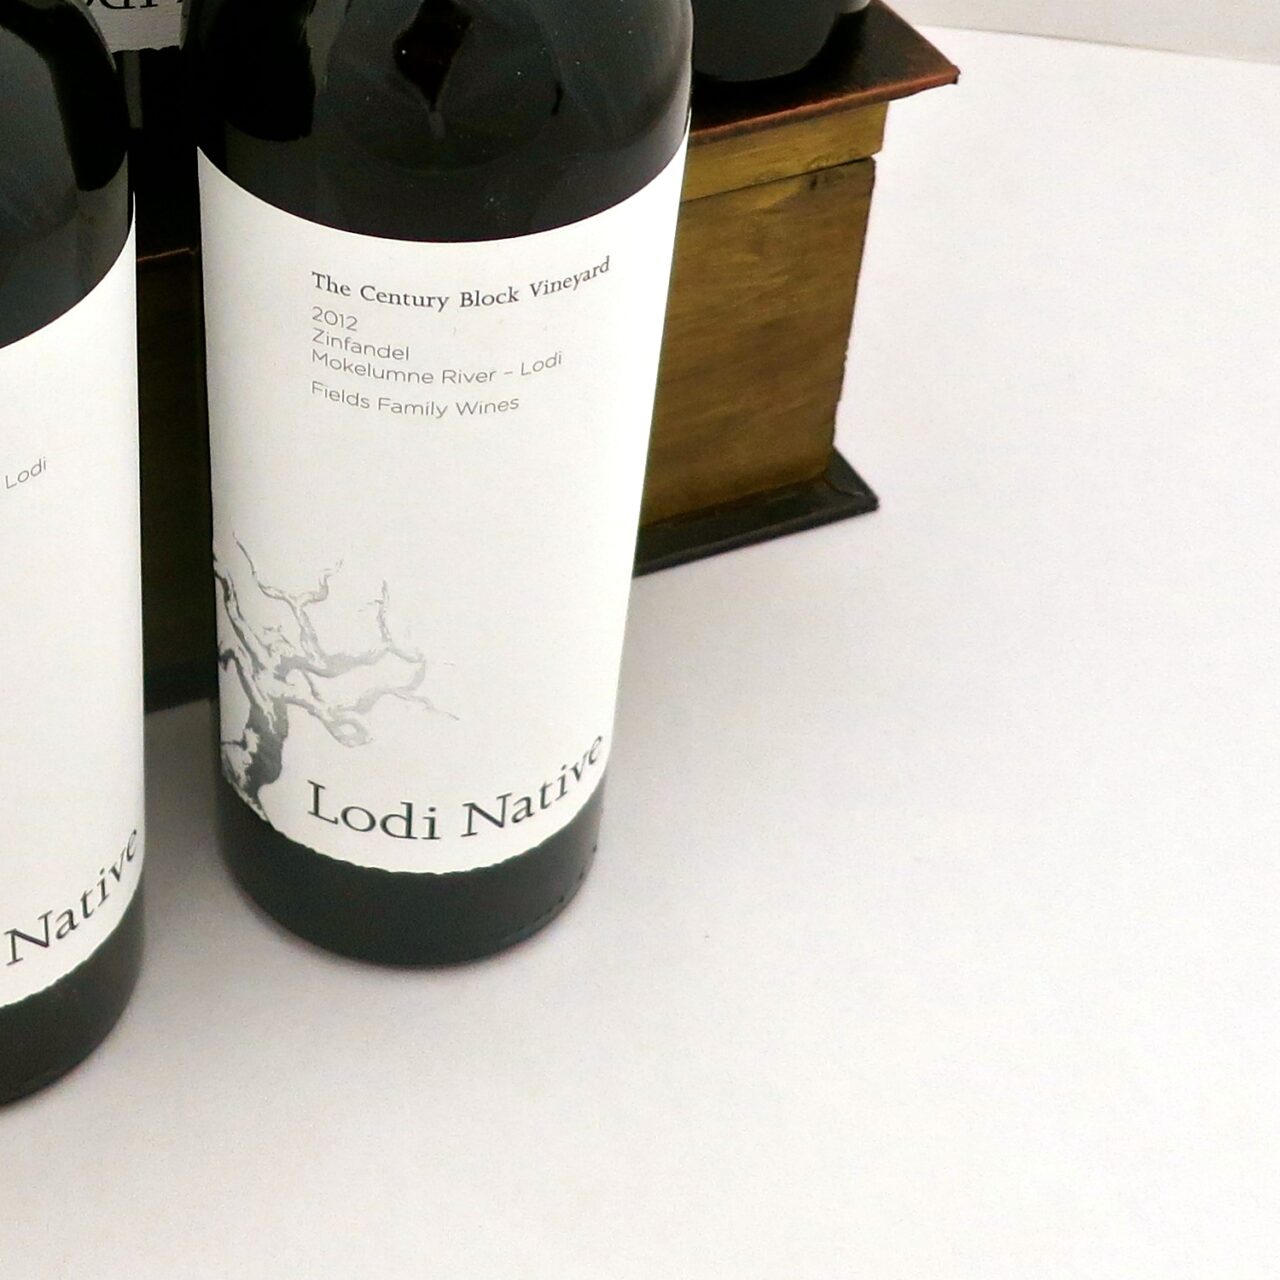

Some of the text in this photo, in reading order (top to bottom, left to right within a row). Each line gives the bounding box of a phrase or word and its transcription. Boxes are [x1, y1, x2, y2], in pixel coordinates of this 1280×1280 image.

[312, 255, 611, 312] The Century Block Vineyard
[312, 306, 358, 332] 2012
[312, 328, 410, 361] Zinfandel
[312, 348, 434, 385] Mokelumne
[442, 368, 497, 385] River
[521, 351, 563, 376] Lodi
[312, 381, 520, 419] Fields Family Wines
[5, 456, 48, 491] Lodi
[307, 735, 603, 840] Lodi Native
[3, 829, 137, 966] Native
